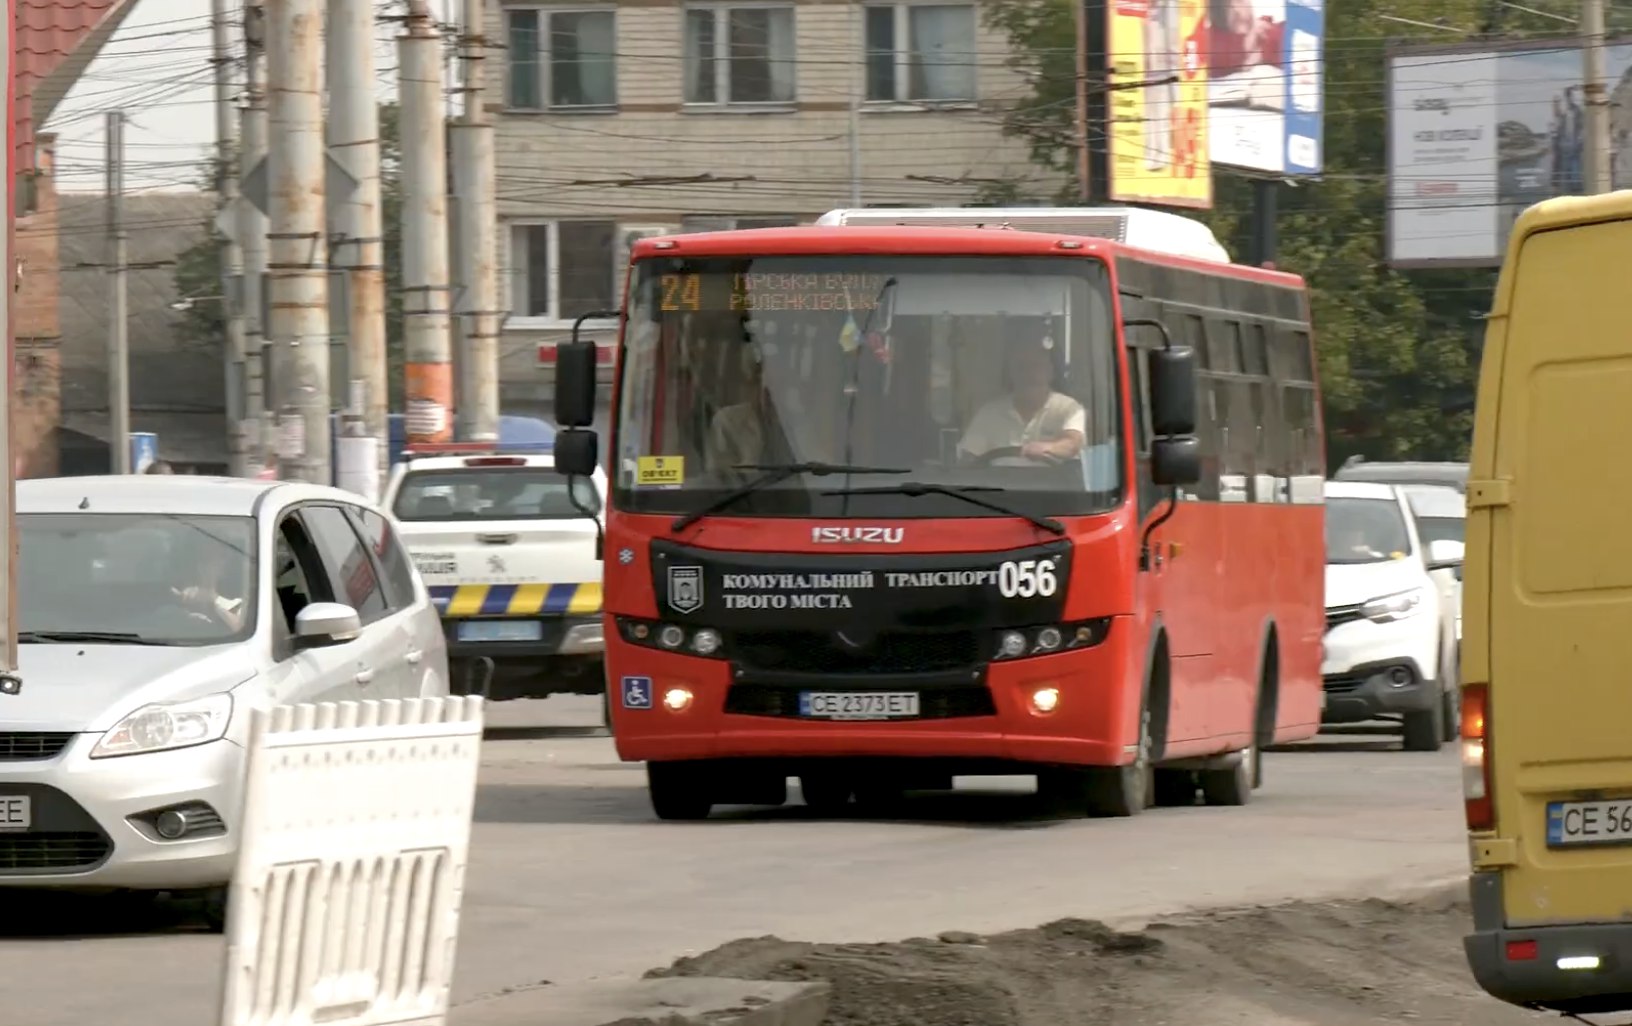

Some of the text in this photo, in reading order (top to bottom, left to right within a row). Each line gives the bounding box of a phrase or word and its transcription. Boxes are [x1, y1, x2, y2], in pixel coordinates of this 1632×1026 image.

[660, 274, 700, 311] 24
[811, 527, 904, 543] ISUZU
[722, 571, 999, 588] КОМУНАЛЬНИЙ ТРАНСПОРТ
[999, 560, 1057, 598] 056
[722, 594, 852, 609] ТВОГО МІСТА
[1565, 807, 1599, 835] CE
